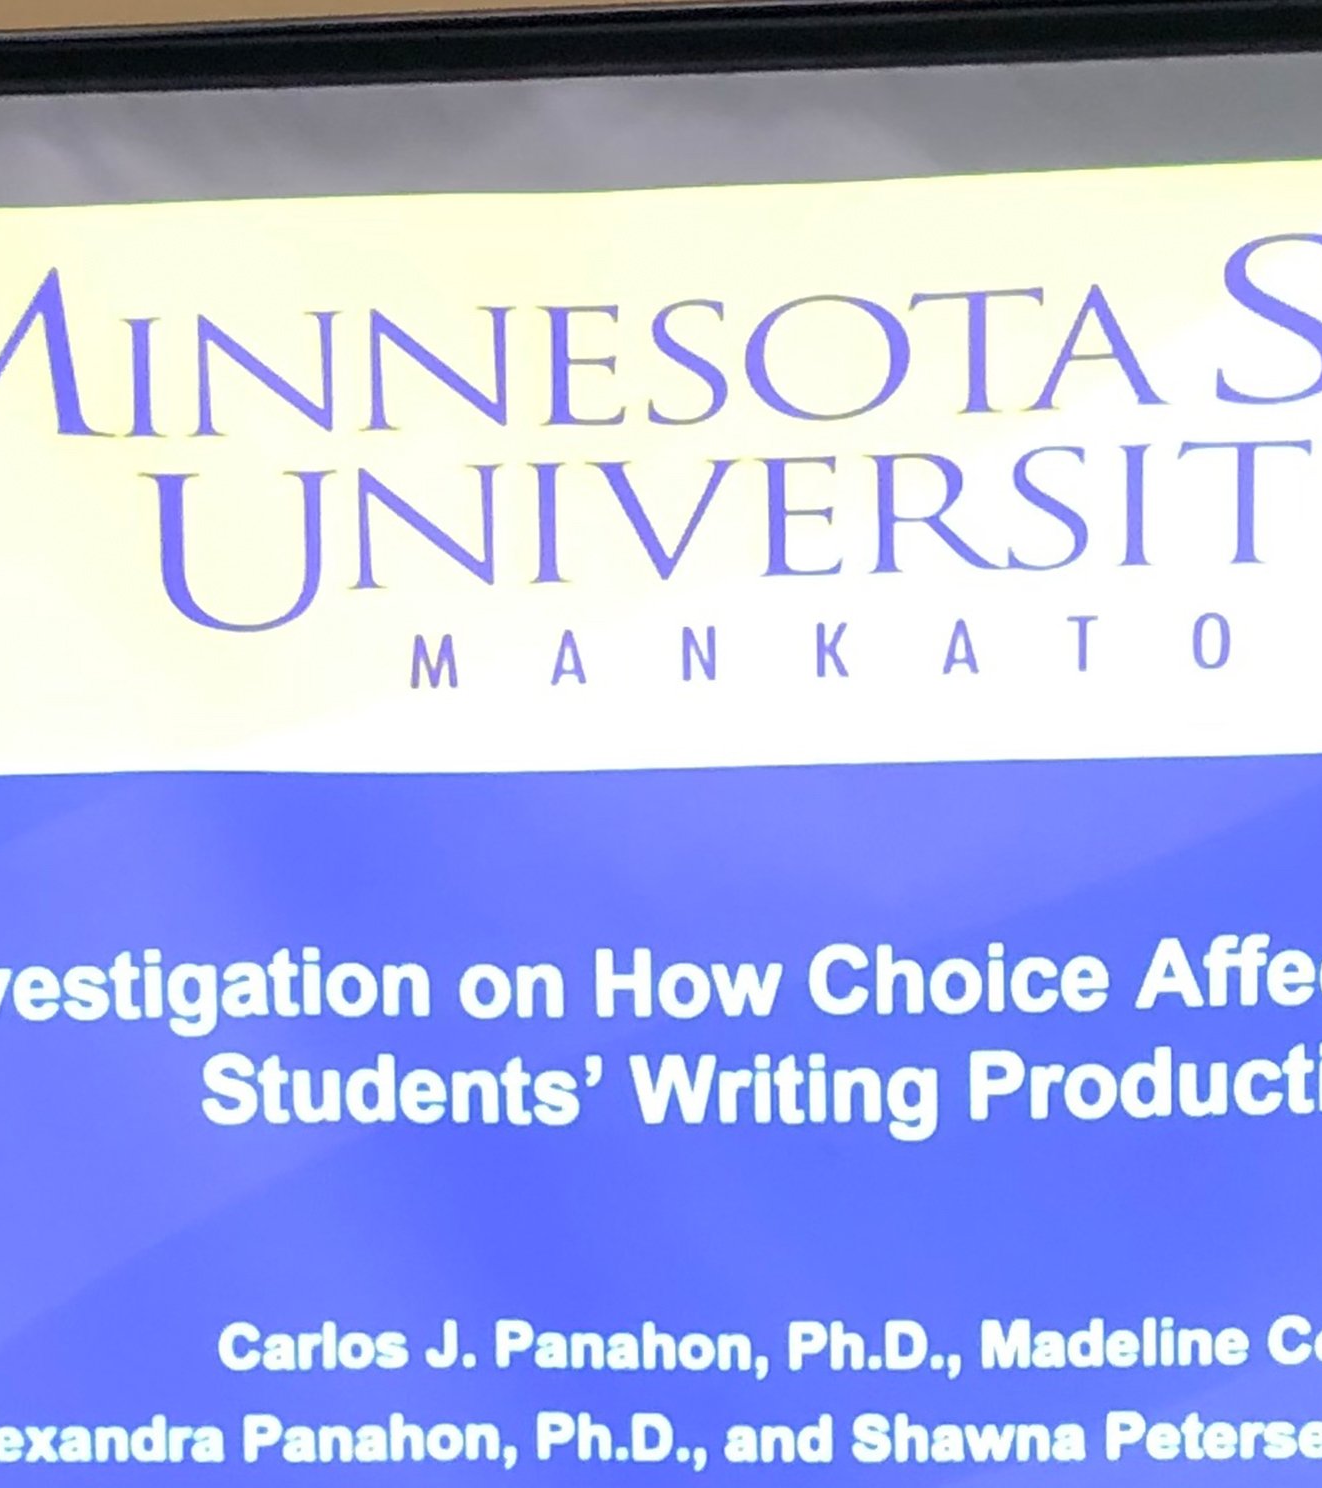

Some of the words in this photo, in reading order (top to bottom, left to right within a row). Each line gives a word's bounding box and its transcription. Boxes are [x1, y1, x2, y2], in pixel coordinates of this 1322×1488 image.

[410, 611, 1239, 690] MANKATO
[459, 963, 564, 1019] on
[595, 947, 783, 1019] How
[808, 942, 1110, 1015] Choice
[201, 1053, 603, 1126] Students’
[629, 1053, 938, 1142] Writing
[218, 1320, 409, 1371] Carlos
[425, 1319, 477, 1369] J.
[495, 1319, 769, 1380] Panahon,
[788, 1320, 962, 1379] Ph.D.,
[981, 1316, 1250, 1369] Madeline
[243, 1412, 518, 1470] Panahon,
[536, 1411, 707, 1472] Ph.D.,
[724, 1413, 833, 1463] and
[851, 1413, 1087, 1463] Shawna
